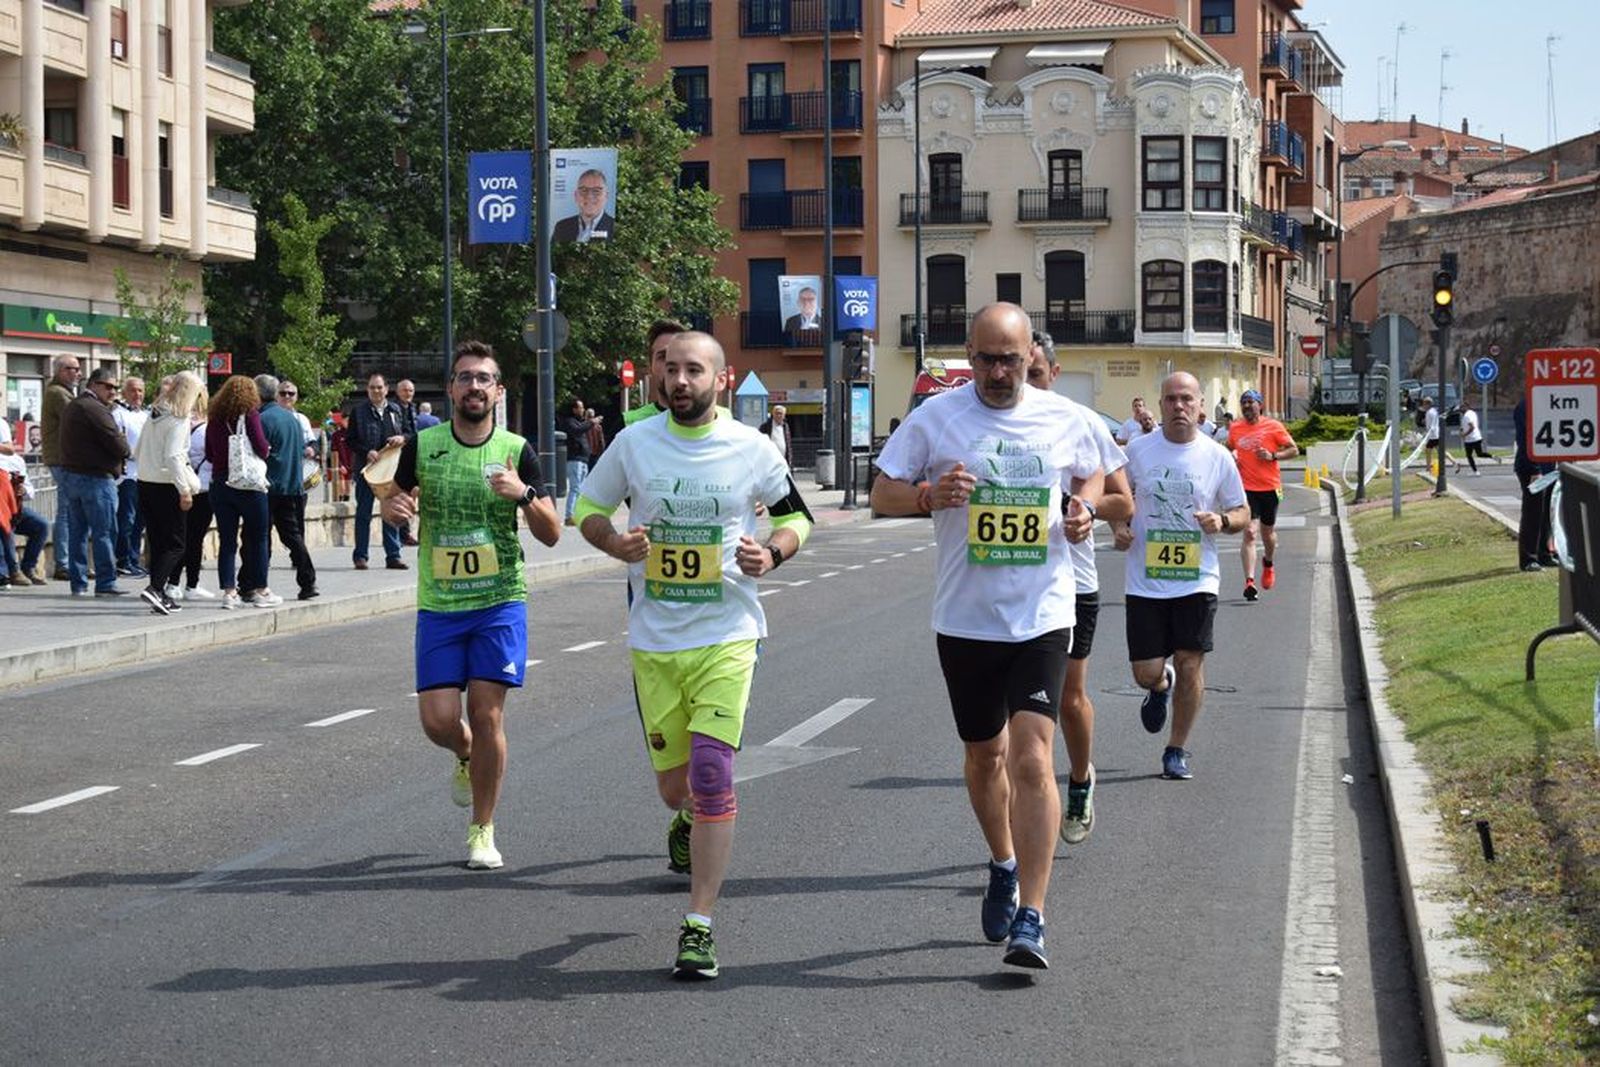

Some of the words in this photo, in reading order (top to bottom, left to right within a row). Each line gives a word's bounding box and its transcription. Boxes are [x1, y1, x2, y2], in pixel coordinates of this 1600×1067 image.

[479, 176, 518, 190] VOTA
[843, 289, 870, 299] VOTA
[1533, 358, 1595, 379] N-122
[1550, 394, 1579, 410] km
[1535, 418, 1595, 449] 459
[977, 511, 1040, 543] 658
[446, 550, 480, 575] 70
[661, 548, 701, 579] 59
[1158, 545, 1186, 565] 45
